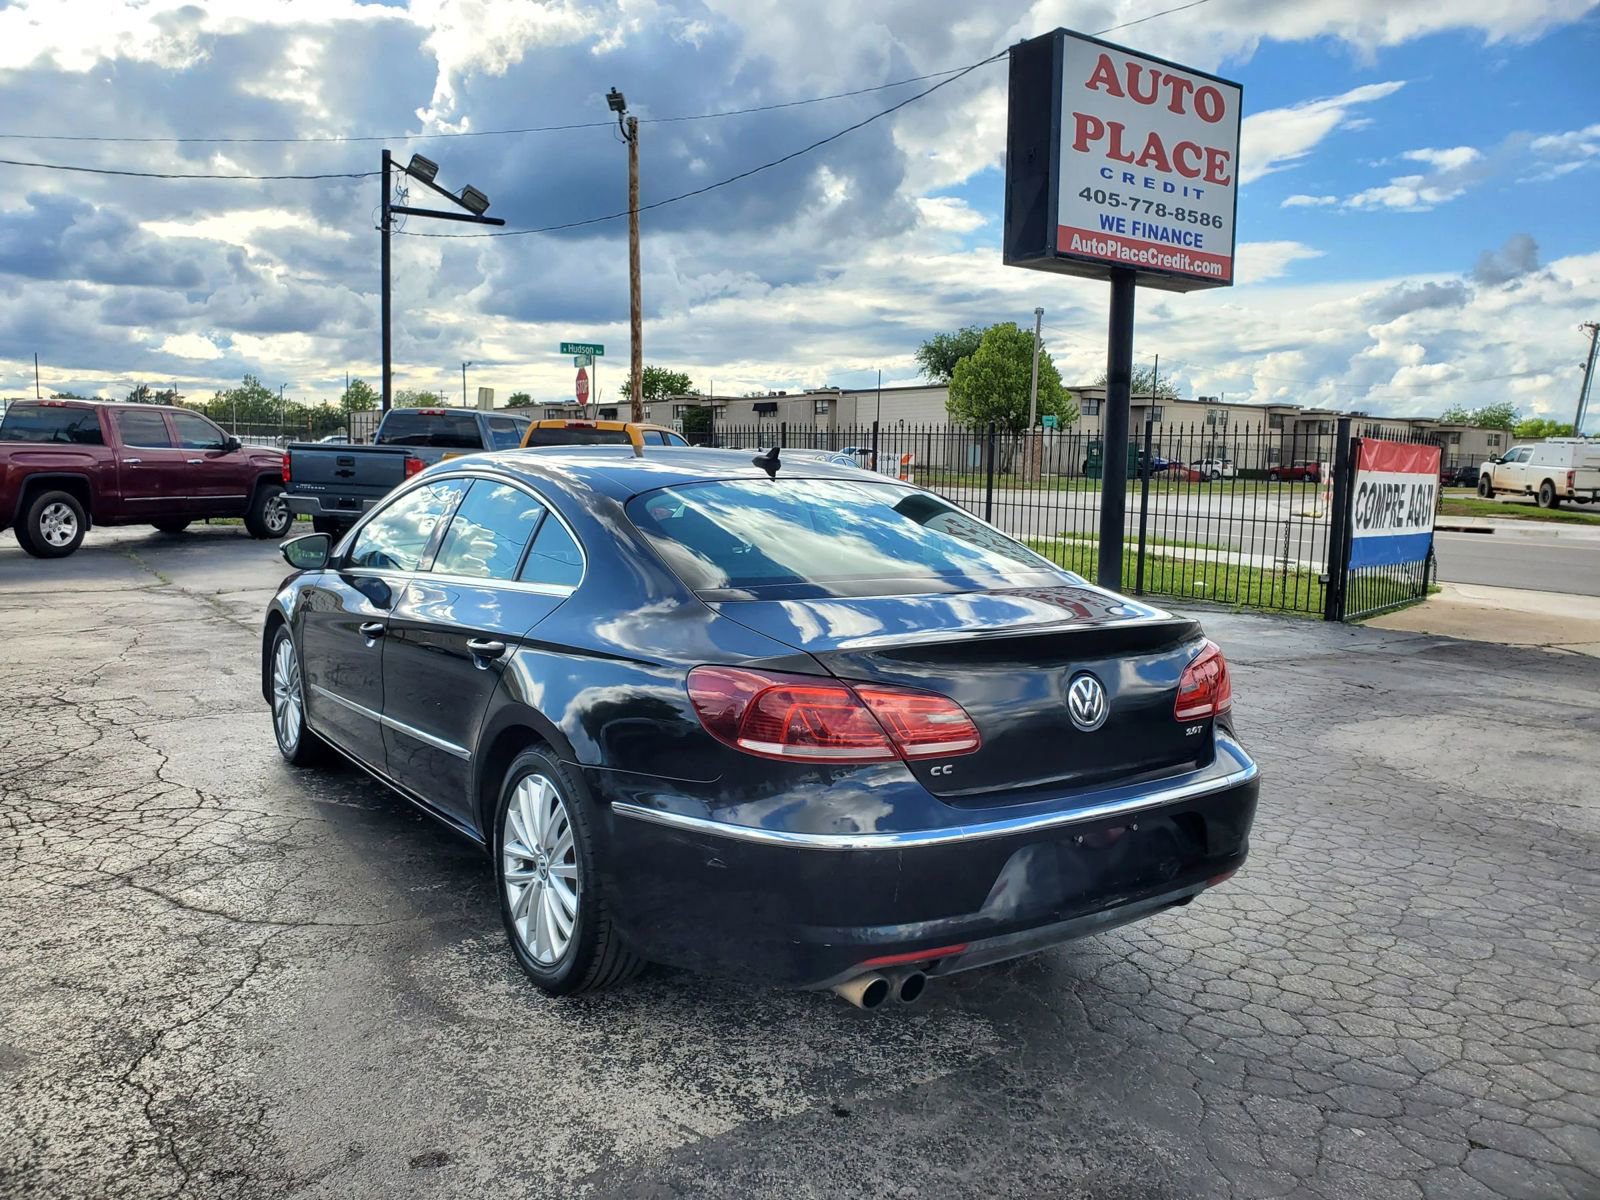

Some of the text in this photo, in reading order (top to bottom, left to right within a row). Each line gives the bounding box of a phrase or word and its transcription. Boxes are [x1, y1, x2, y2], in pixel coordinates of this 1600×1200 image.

[1085, 52, 1226, 123] AUTO
[1072, 111, 1231, 187] PLACE
[1099, 167, 1205, 200] CREDIT
[1078, 187, 1223, 229] 405-778-8586
[1099, 213, 1204, 249] WE FINANCE
[1070, 233, 1222, 276] AutoPlaceCredit.com
[568, 344, 594, 355] Hudson
[576, 379, 588, 395] STOP
[1355, 481, 1434, 530] COMPRE AQUI
[930, 764, 953, 776] CC
